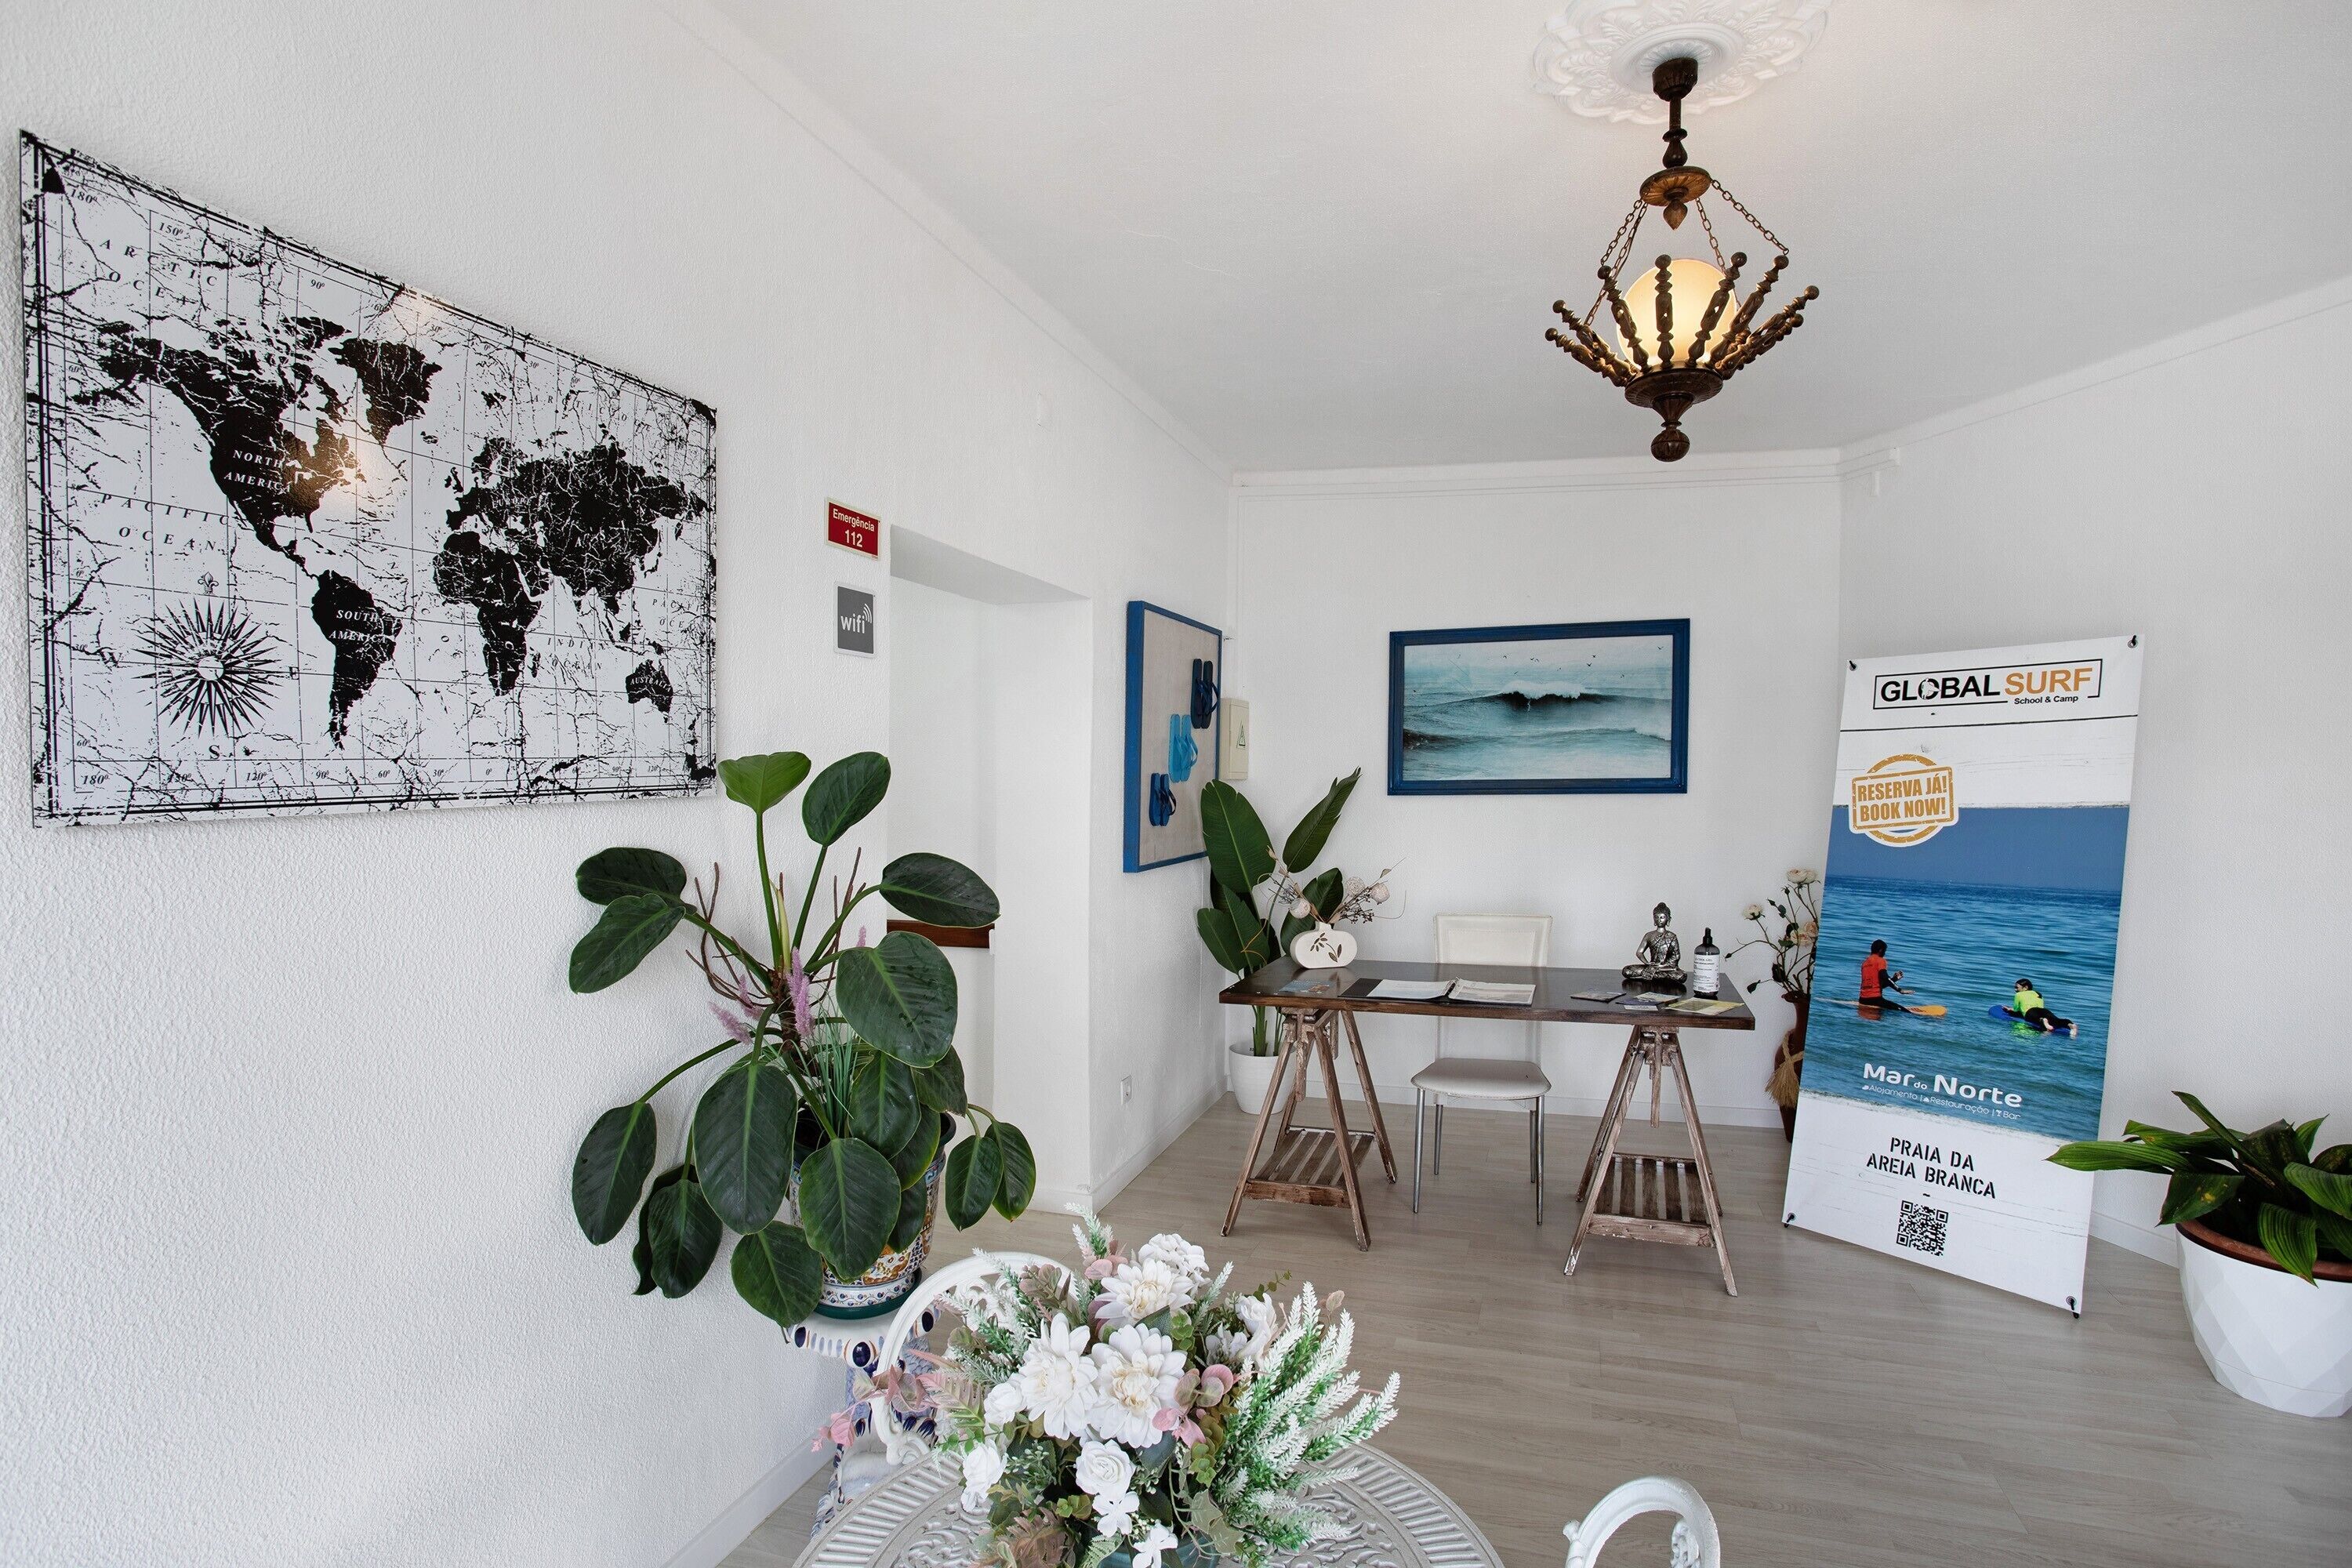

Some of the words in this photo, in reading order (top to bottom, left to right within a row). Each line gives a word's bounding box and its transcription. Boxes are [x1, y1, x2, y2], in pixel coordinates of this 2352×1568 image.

[100, 238, 217, 286] ARCTIC
[233, 449, 283, 469] NORTH
[224, 471, 291, 492] AMERICA
[101, 493, 229, 525] PACIFIC
[833, 508, 875, 532] Emergência
[118, 526, 216, 550] OCEAN
[844, 529, 863, 548] 112
[336, 609, 379, 622] SOUTH
[840, 613, 865, 633] wifi
[329, 630, 386, 644] AMERICA
[630, 677, 672, 692] AUSTRALIA
[1881, 674, 2001, 702] GLOBAL
[2004, 667, 2093, 695] SURF
[2014, 695, 2043, 705] School
[2055, 695, 2079, 705] Camp
[209, 744, 221, 760] S
[1857, 779, 1923, 802] RESERVA
[1926, 772, 1947, 795] JÁ!
[1860, 801, 1901, 822] BOOK
[1904, 797, 1947, 818] NOW!
[1863, 1062, 1915, 1087] Mar
[1914, 1081, 1928, 1090] do
[1933, 1074, 2023, 1108] Norte
[1869, 1084, 1918, 1101] Alojamento
[1930, 1096, 1990, 1115] Restauração
[2003, 1111, 2021, 1120] Bar
[1890, 1137, 1941, 1164] PRAIA
[1950, 1150, 1974, 1172] DA
[1866, 1152, 1916, 1179] AREIA
[1925, 1166, 1995, 1200] BRANCA
